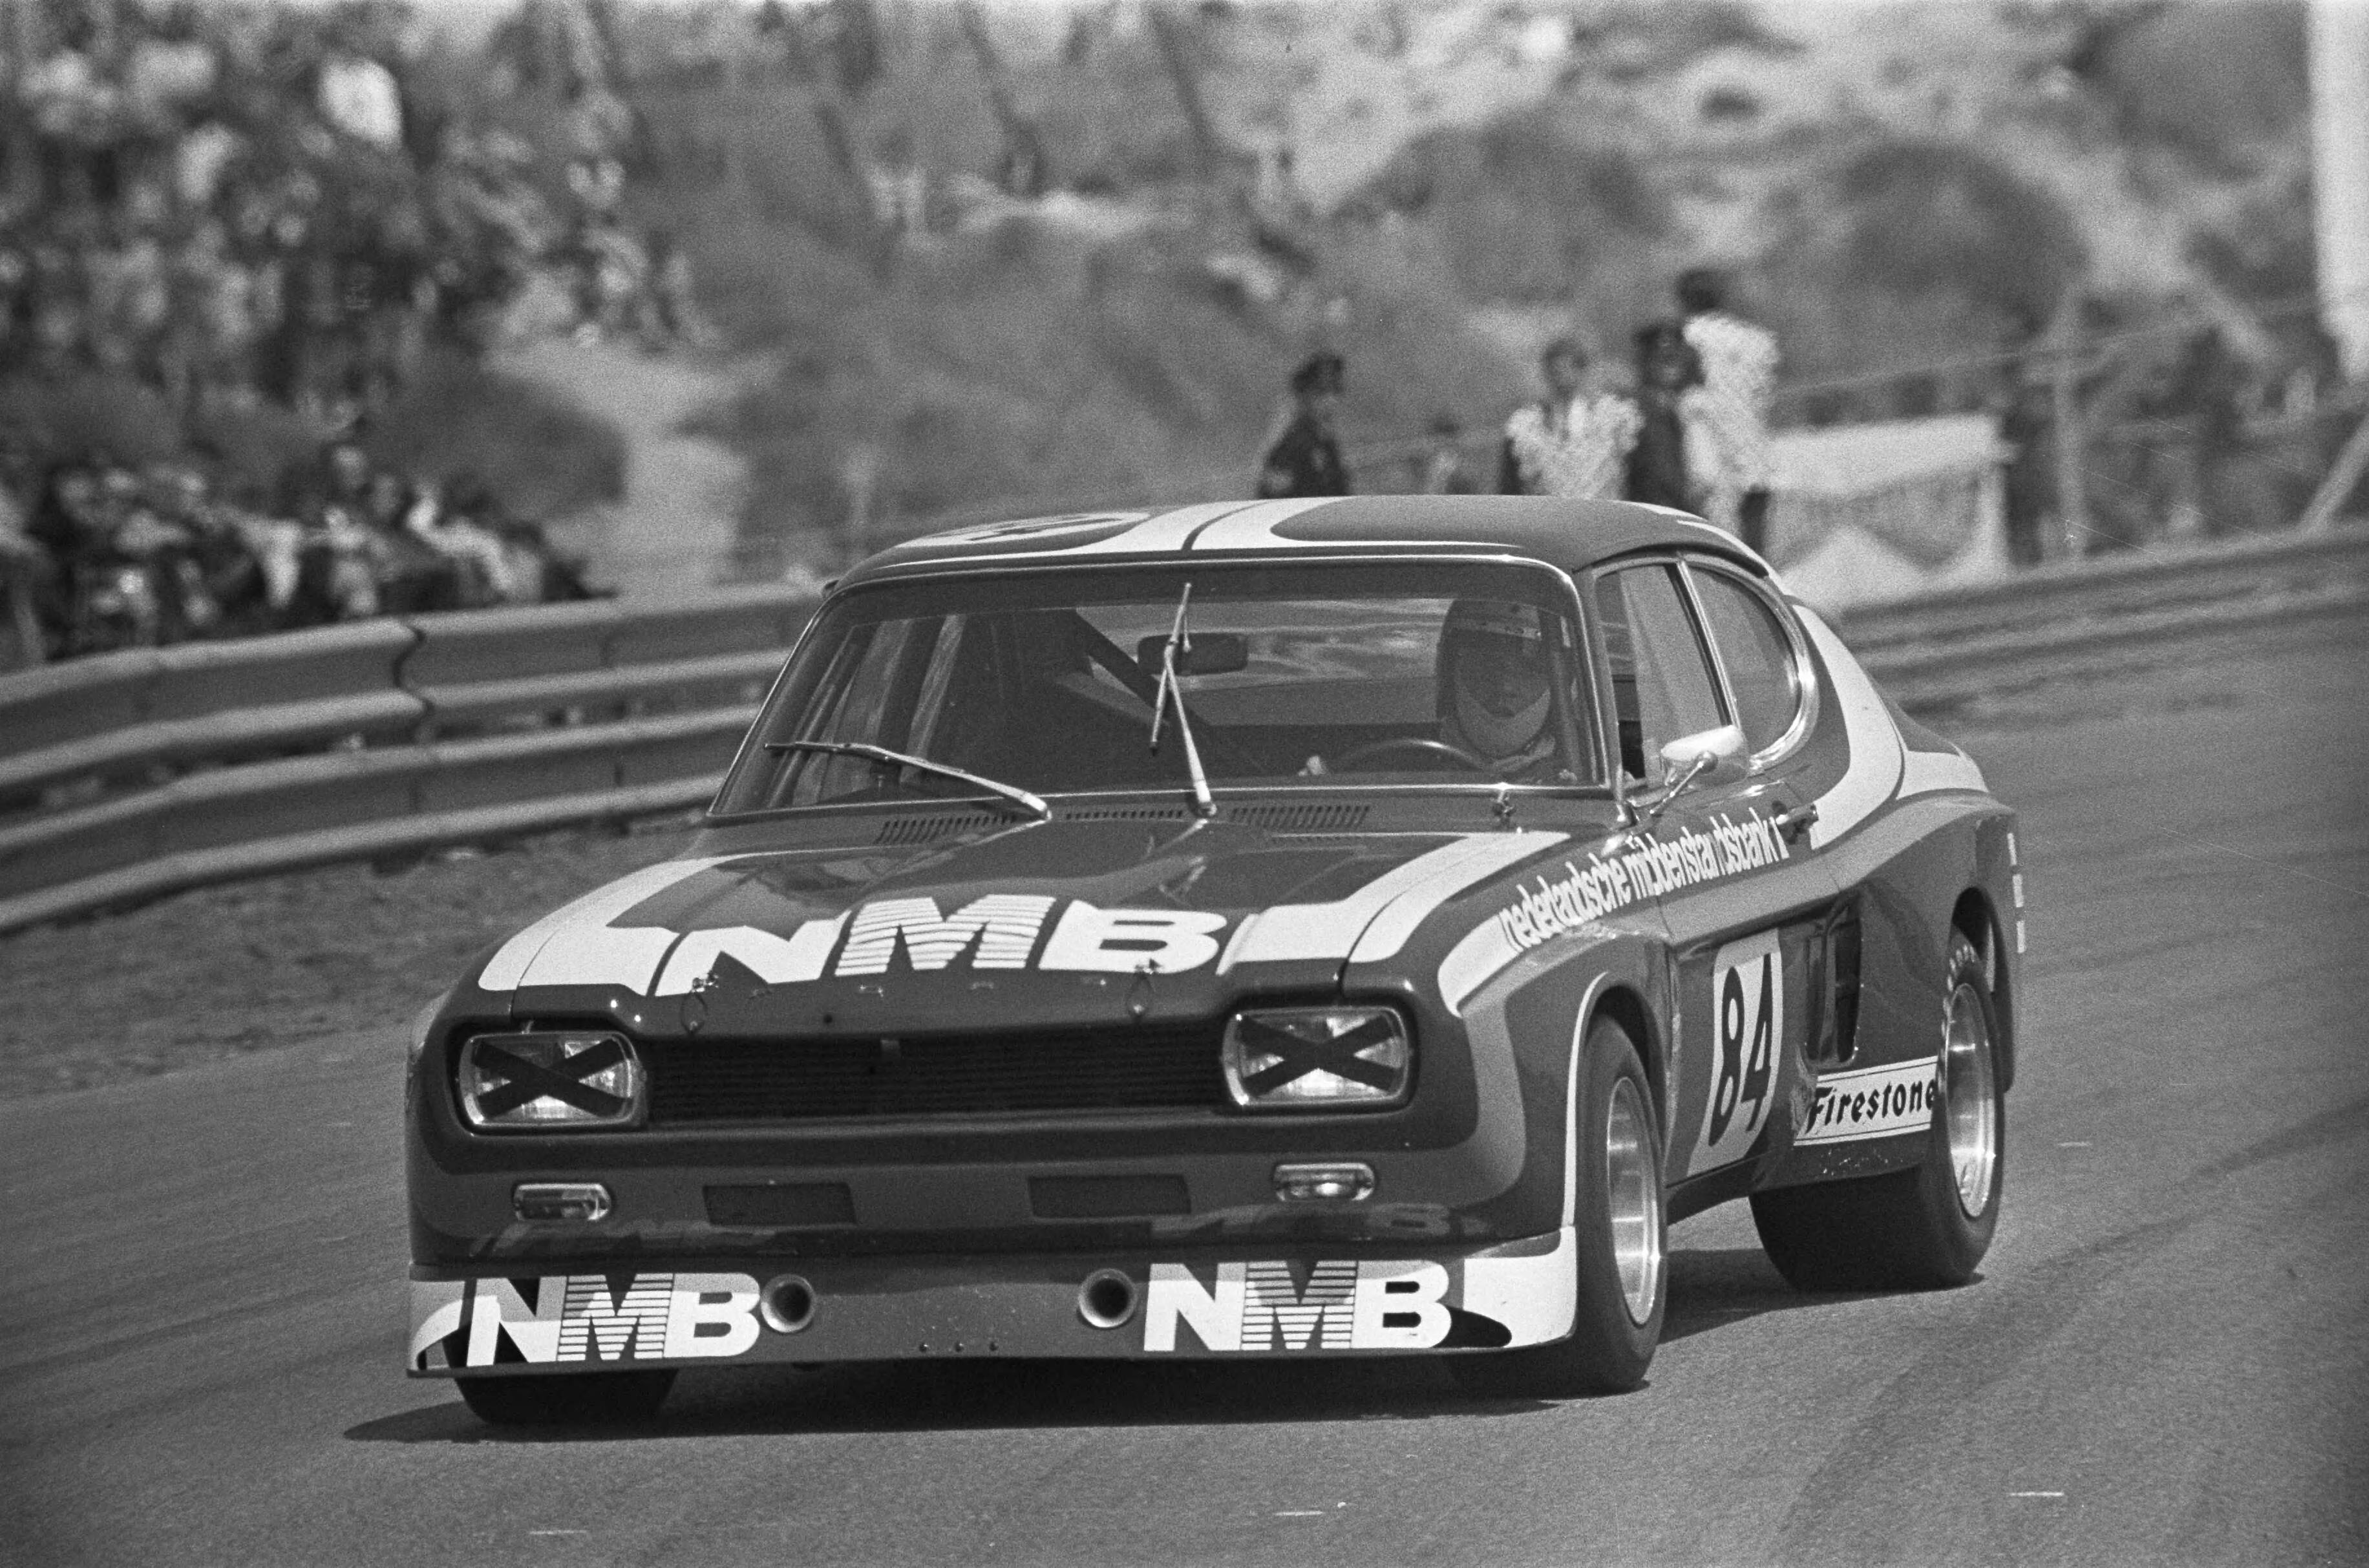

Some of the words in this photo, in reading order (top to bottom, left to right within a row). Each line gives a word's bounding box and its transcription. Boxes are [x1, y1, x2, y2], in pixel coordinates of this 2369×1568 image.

[654, 894, 1227, 997] NMB
[1708, 953, 1772, 1147] 84
[1805, 1079, 1935, 1134] Firestone
[466, 1273, 760, 1367] NMB
[1143, 1260, 1452, 1351] NMB
